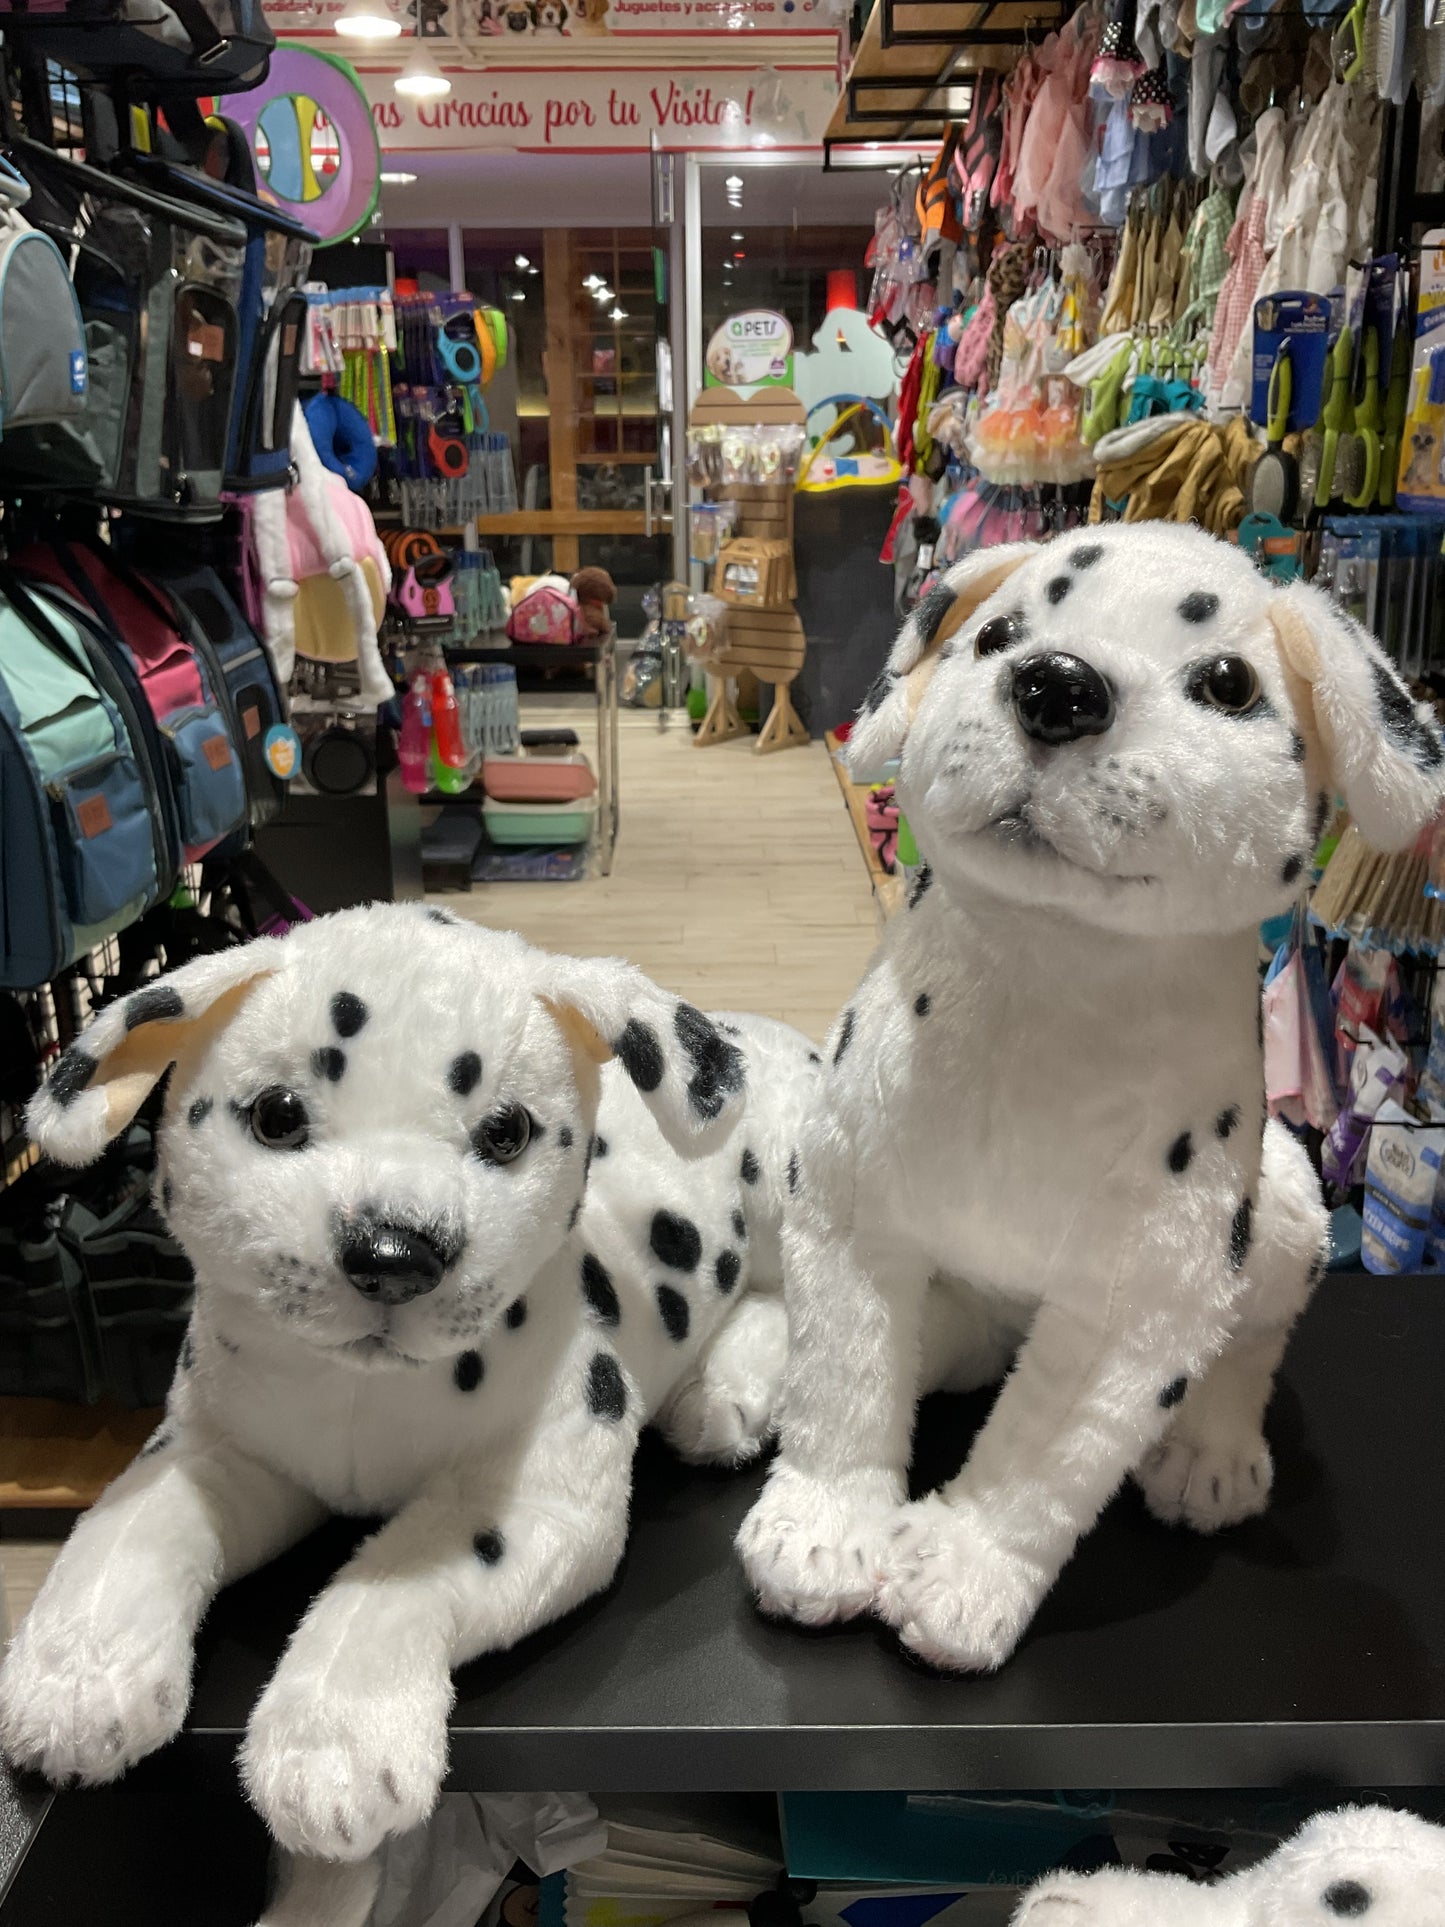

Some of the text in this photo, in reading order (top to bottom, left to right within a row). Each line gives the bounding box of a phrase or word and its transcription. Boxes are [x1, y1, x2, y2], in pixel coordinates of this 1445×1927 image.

[614, 0, 681, 15] Juguetes
[685, 2, 693, 14] y
[416, 90, 531, 129] Gracias
[545, 99, 596, 143] por
[608, 88, 641, 126] tu
